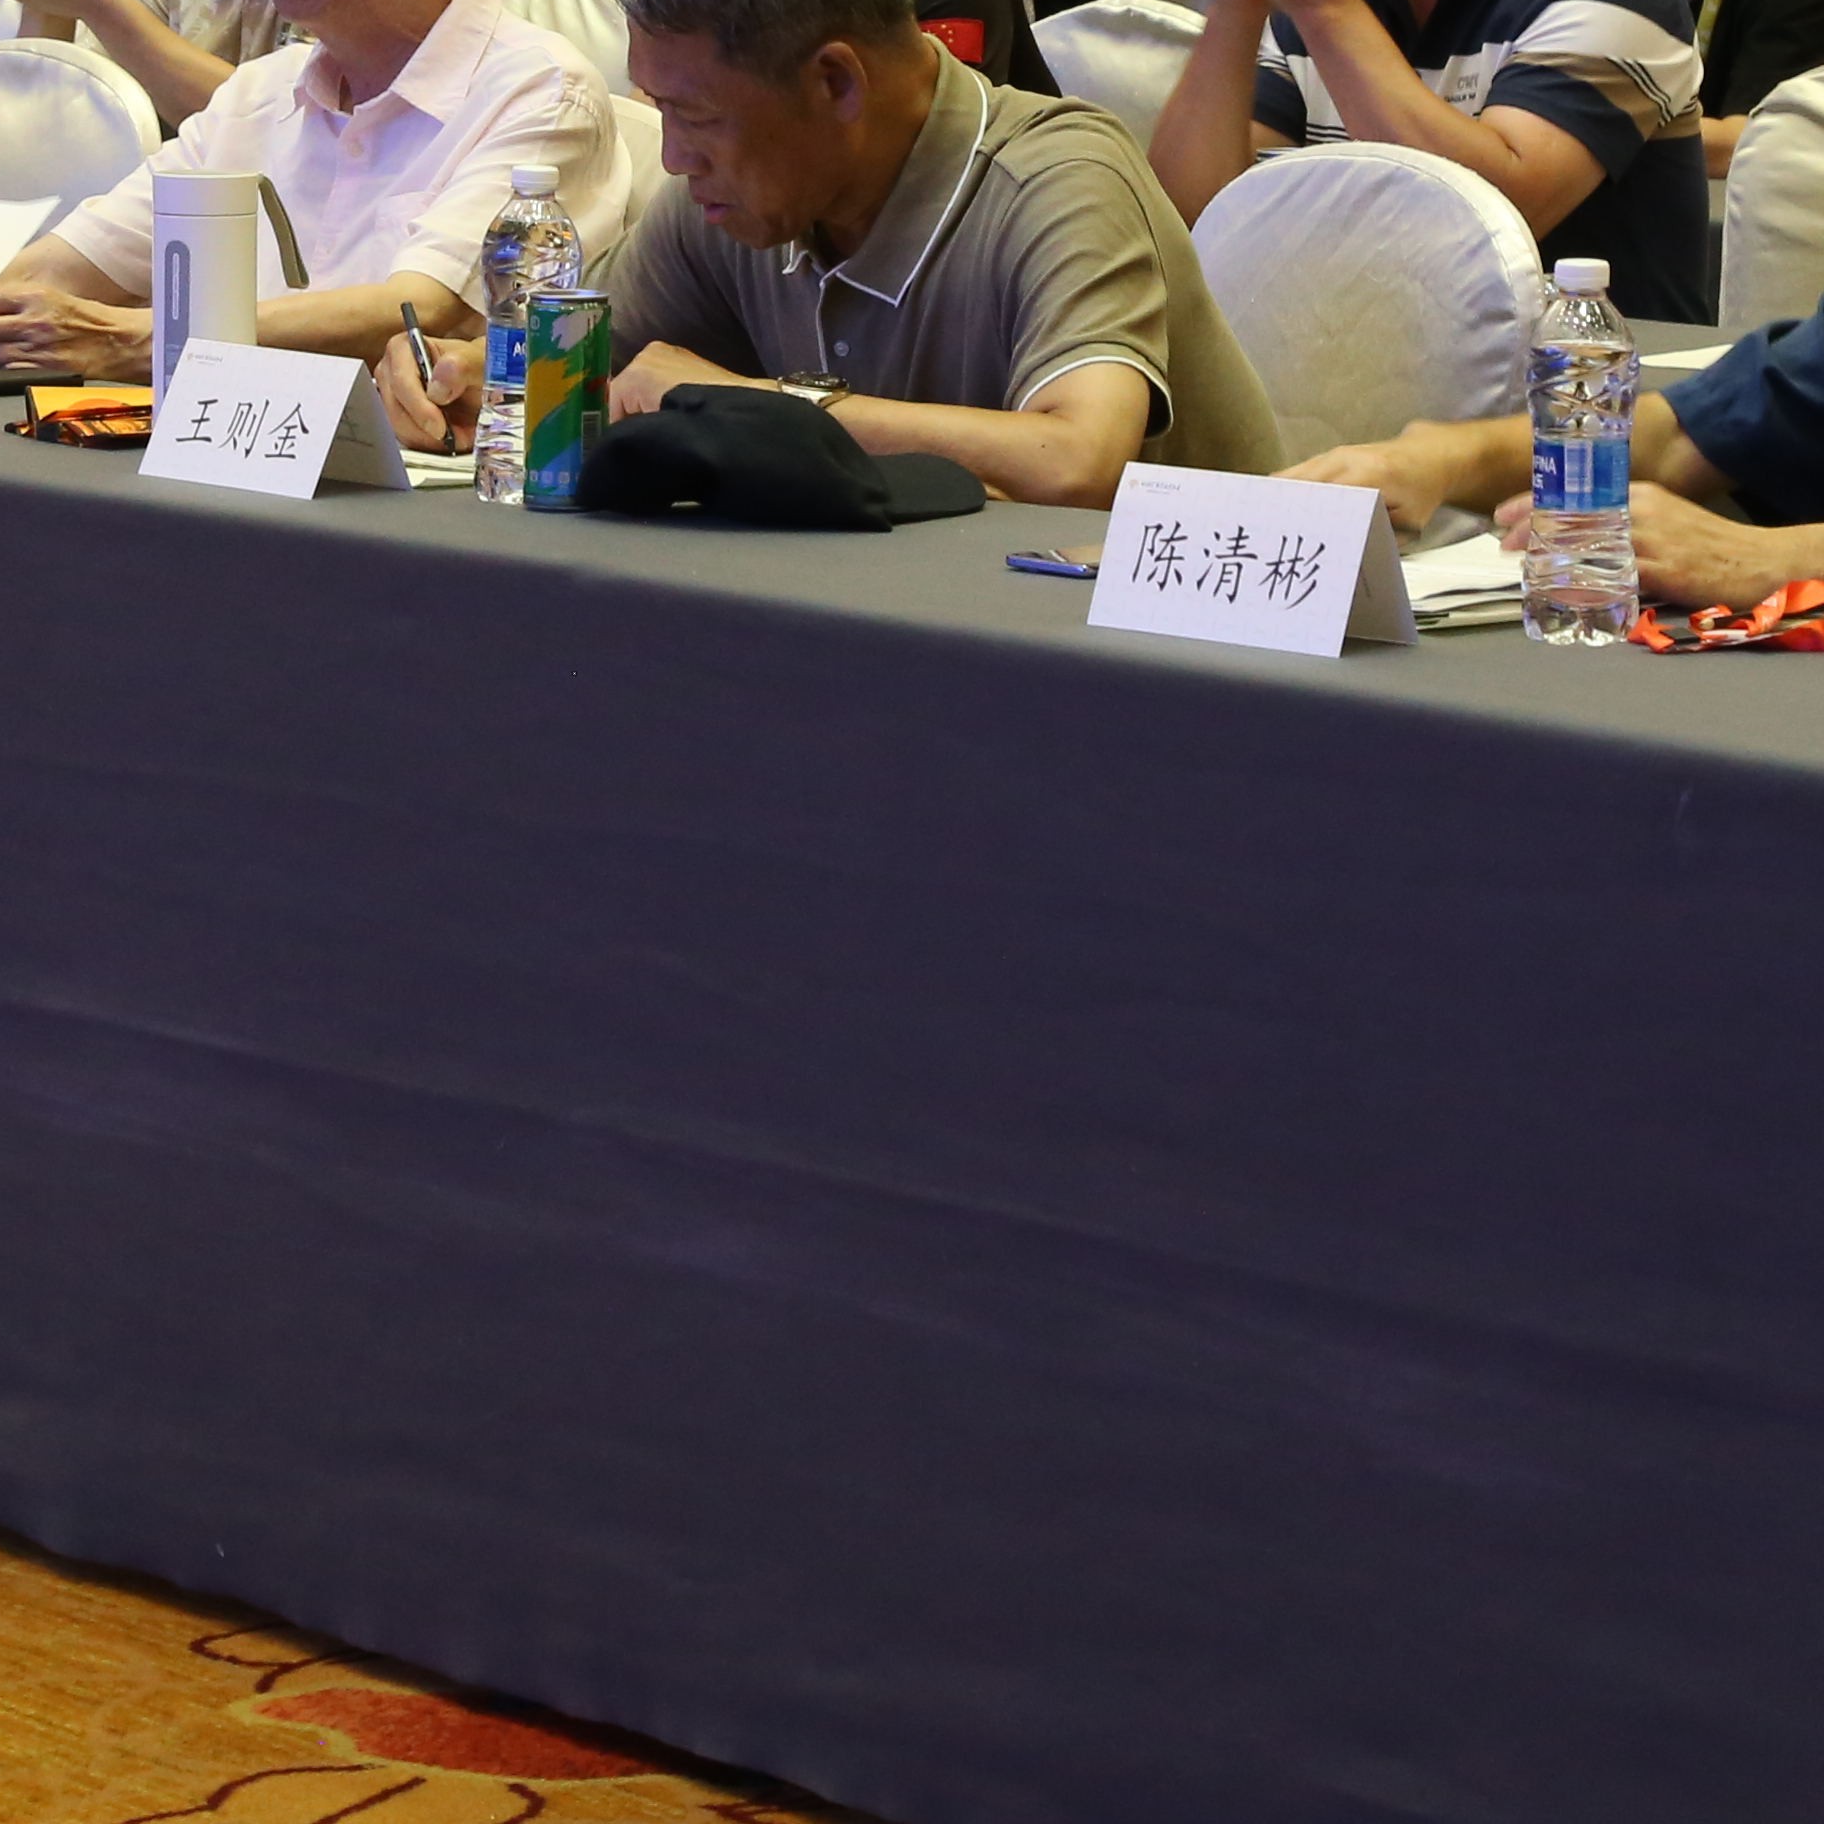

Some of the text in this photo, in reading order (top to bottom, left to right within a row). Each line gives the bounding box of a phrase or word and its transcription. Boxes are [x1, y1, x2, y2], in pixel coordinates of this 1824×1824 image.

[175, 398, 310, 460] 王则金
[1131, 520, 1327, 610] 陈清彬
